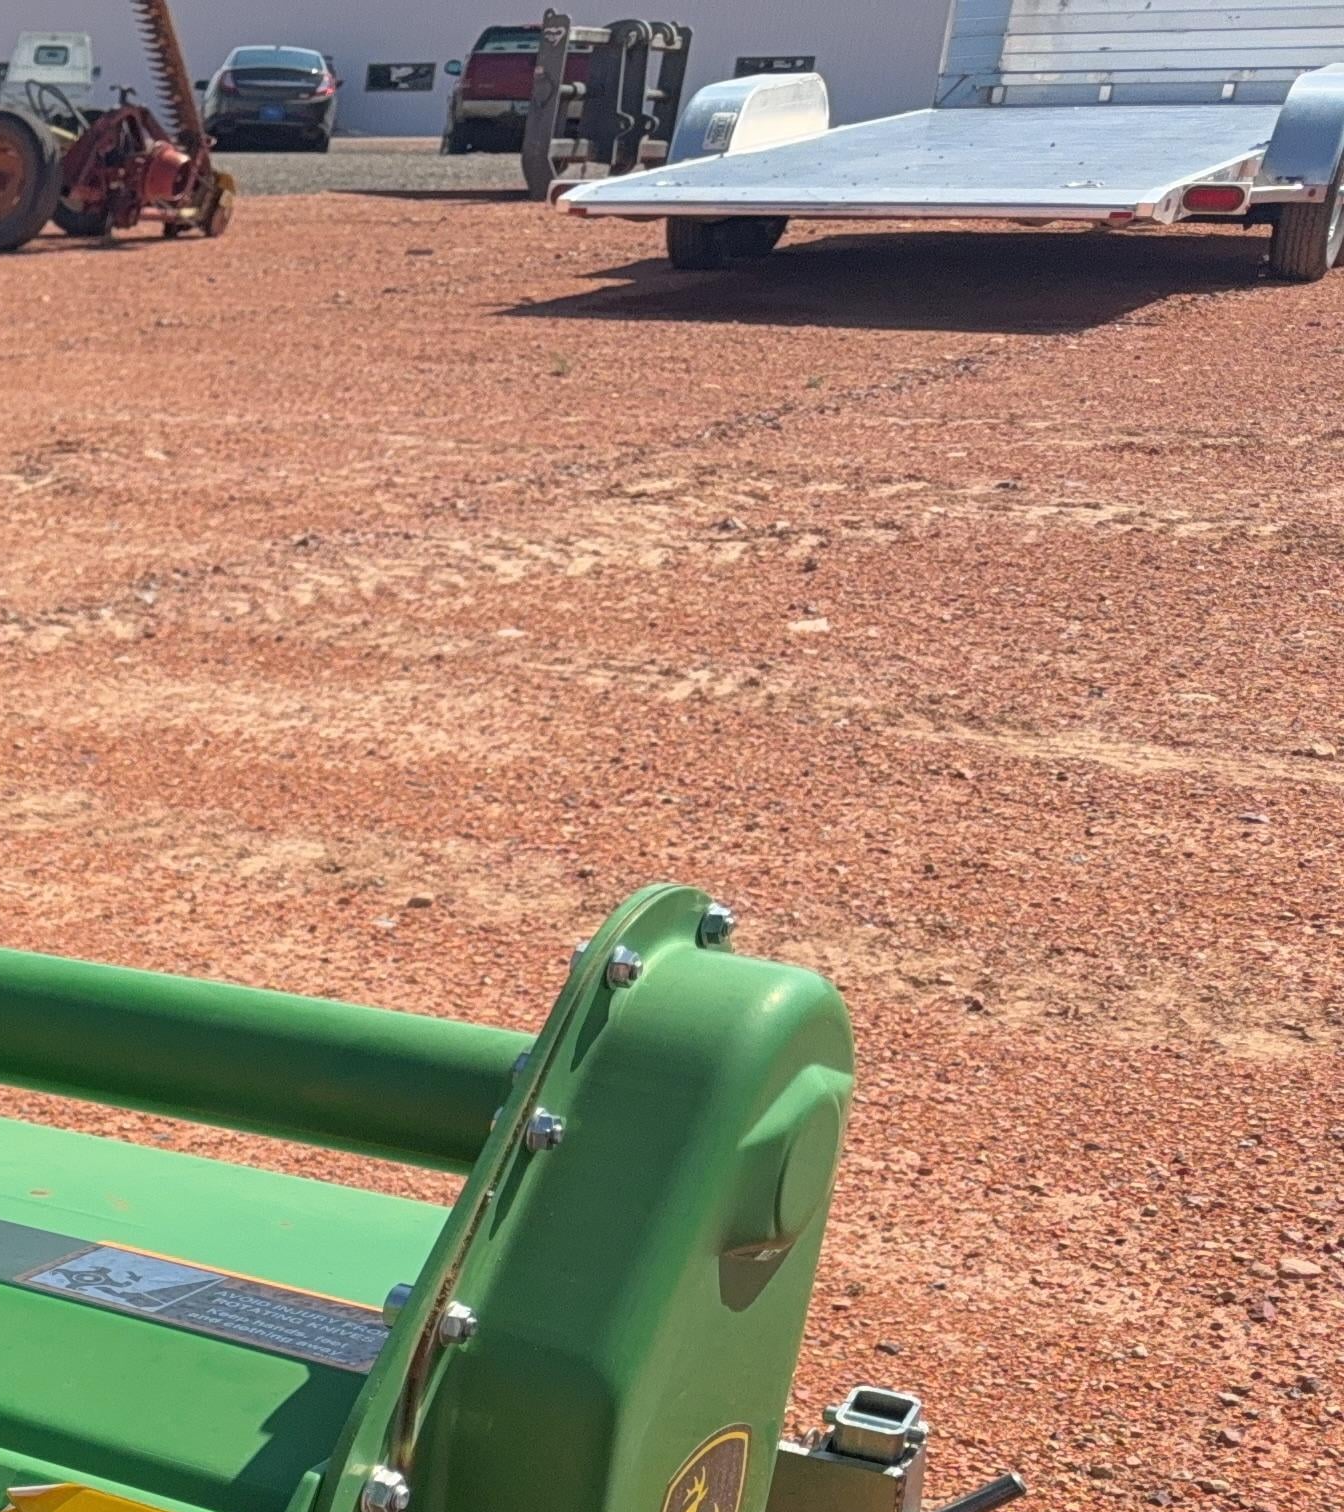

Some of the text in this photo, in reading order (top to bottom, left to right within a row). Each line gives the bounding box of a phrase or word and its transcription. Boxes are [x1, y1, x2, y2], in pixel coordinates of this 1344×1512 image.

[211, 1297, 376, 1344] ROTATING KNIVES
[213, 1290, 272, 1307] AVOID
[272, 1304, 340, 1324] INJURY
[187, 1312, 345, 1356] and clothing away
